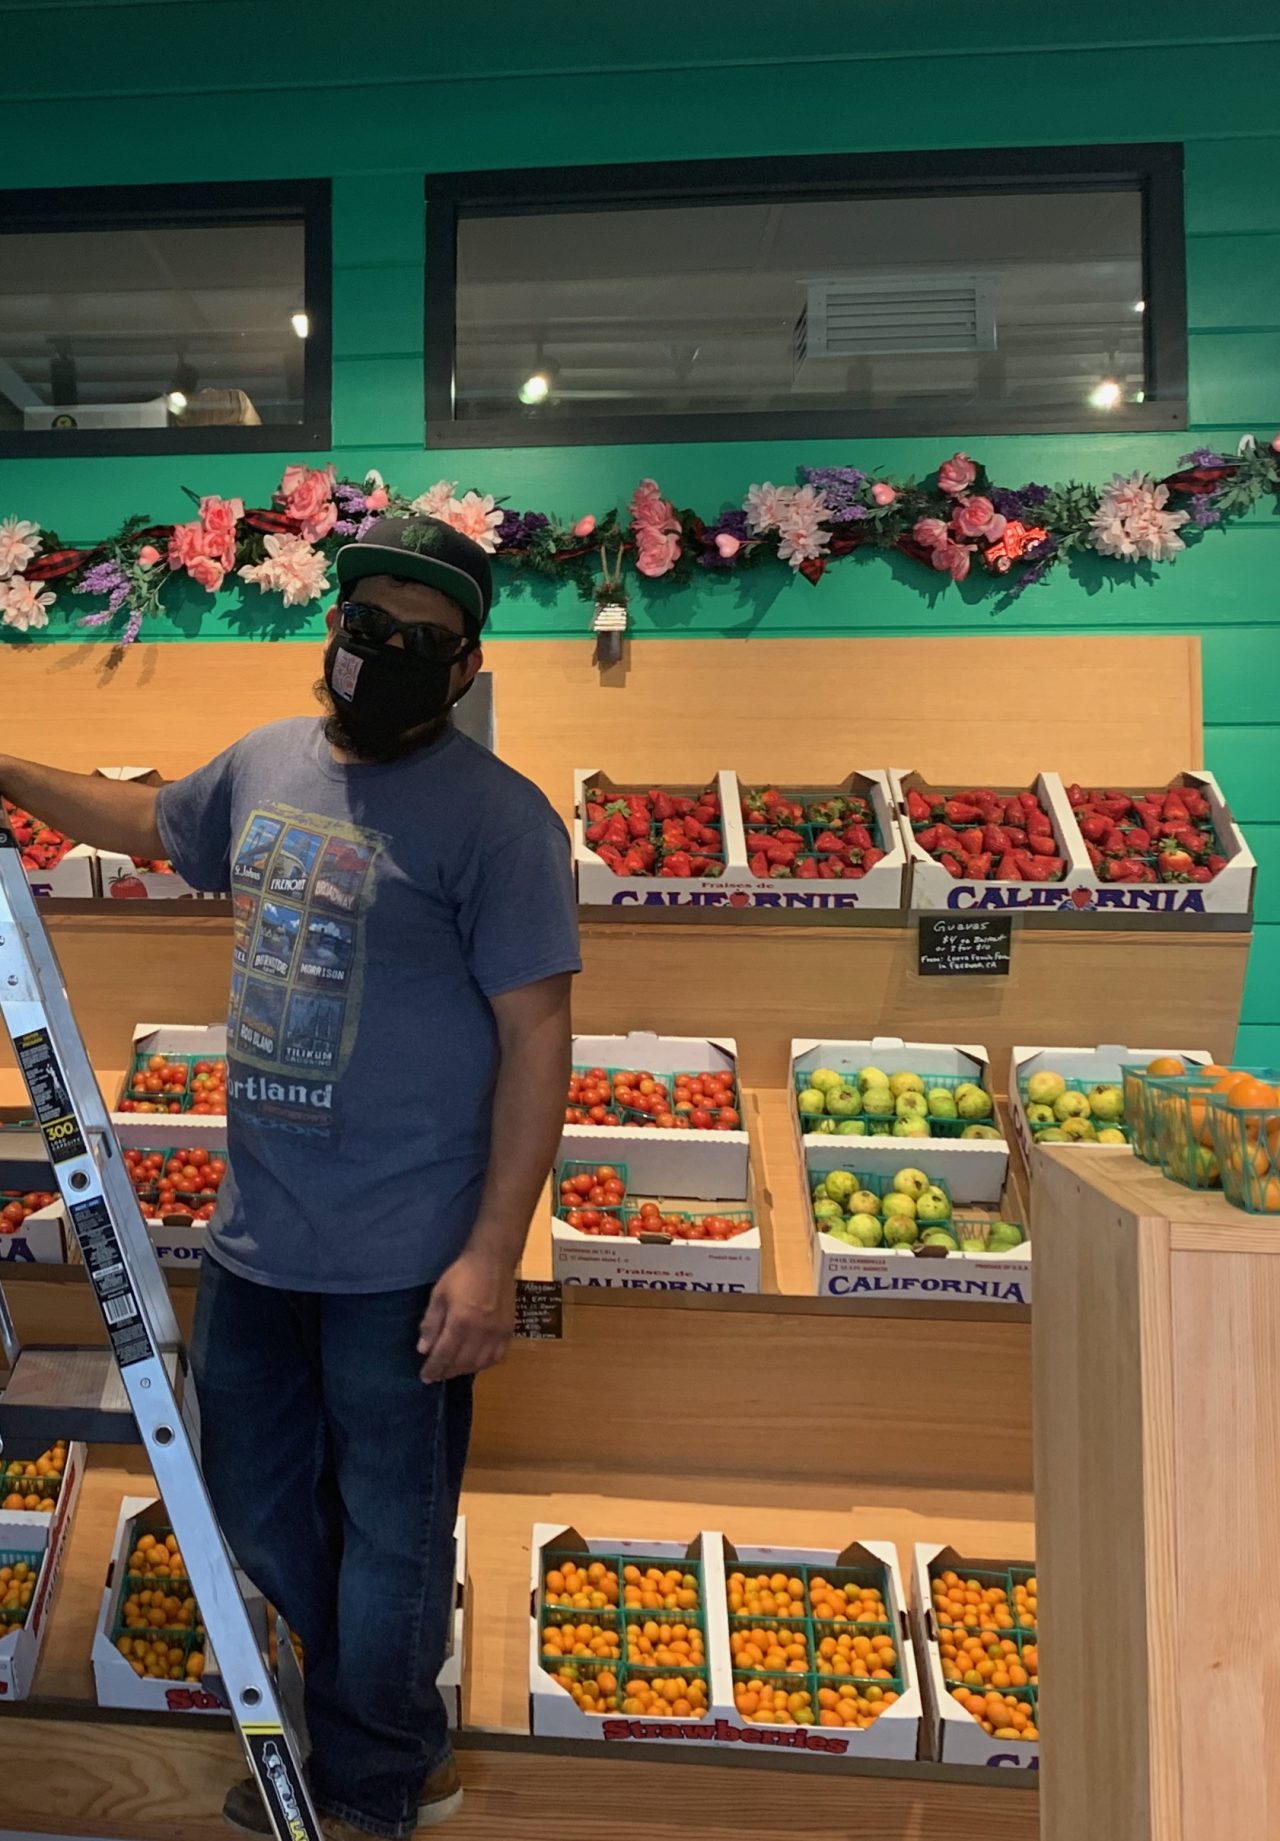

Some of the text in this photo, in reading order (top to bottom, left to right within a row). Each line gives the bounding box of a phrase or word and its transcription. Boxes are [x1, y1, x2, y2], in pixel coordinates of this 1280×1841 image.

[947, 885, 1207, 913] CALIFORNIA
[933, 921, 990, 932] Guavas
[300, 963, 345, 980] MORRISON
[286, 1047, 333, 1060] TILIKUM
[228, 1076, 333, 1108] ortland
[46, 1121, 74, 1141] 300
[828, 1275, 1026, 1304] CALIFORNIA
[602, 1719, 850, 1754] Strawberries
